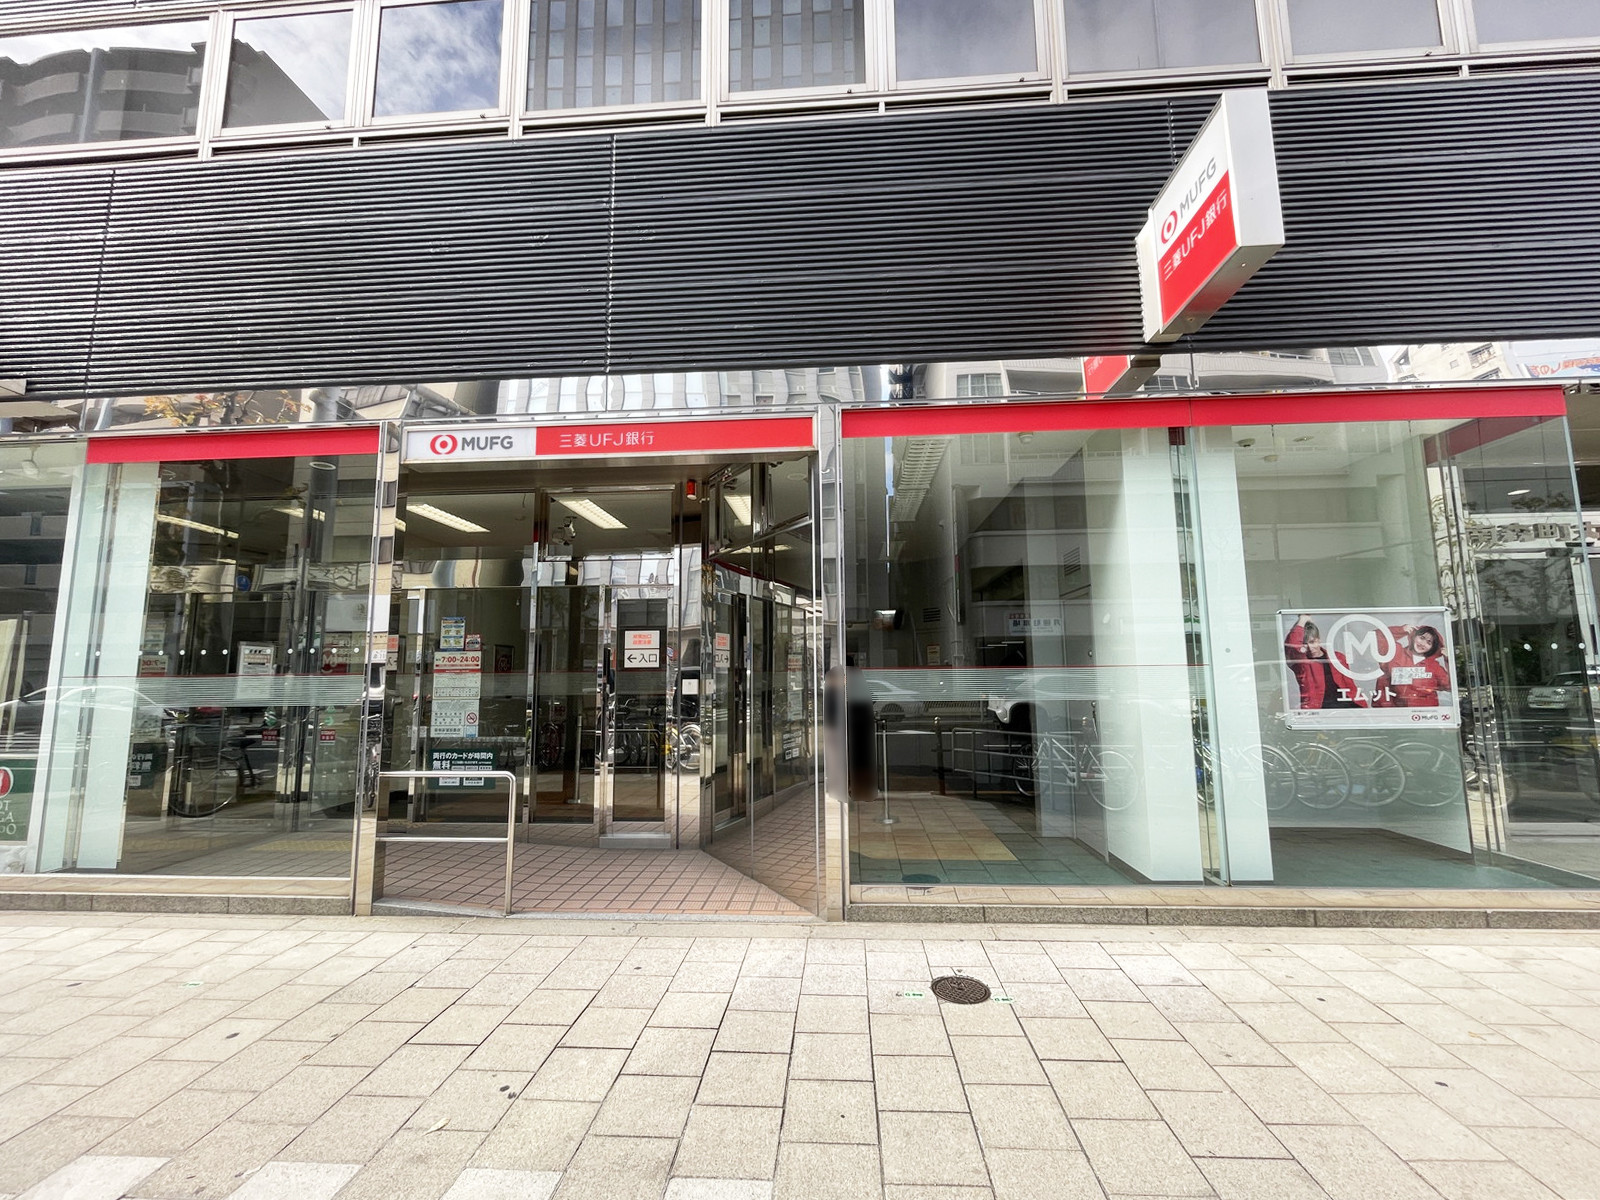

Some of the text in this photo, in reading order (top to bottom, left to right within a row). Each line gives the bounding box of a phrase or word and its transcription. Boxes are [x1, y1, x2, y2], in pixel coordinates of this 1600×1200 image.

[1179, 156, 1217, 219] MUFG
[1163, 188, 1228, 281] 三菱UFJ銀行
[461, 435, 514, 451] MUFG
[559, 431, 655, 448] 三菱UFJ銀行
[639, 653, 658, 664] 入口
[1336, 686, 1397, 702] エムット
